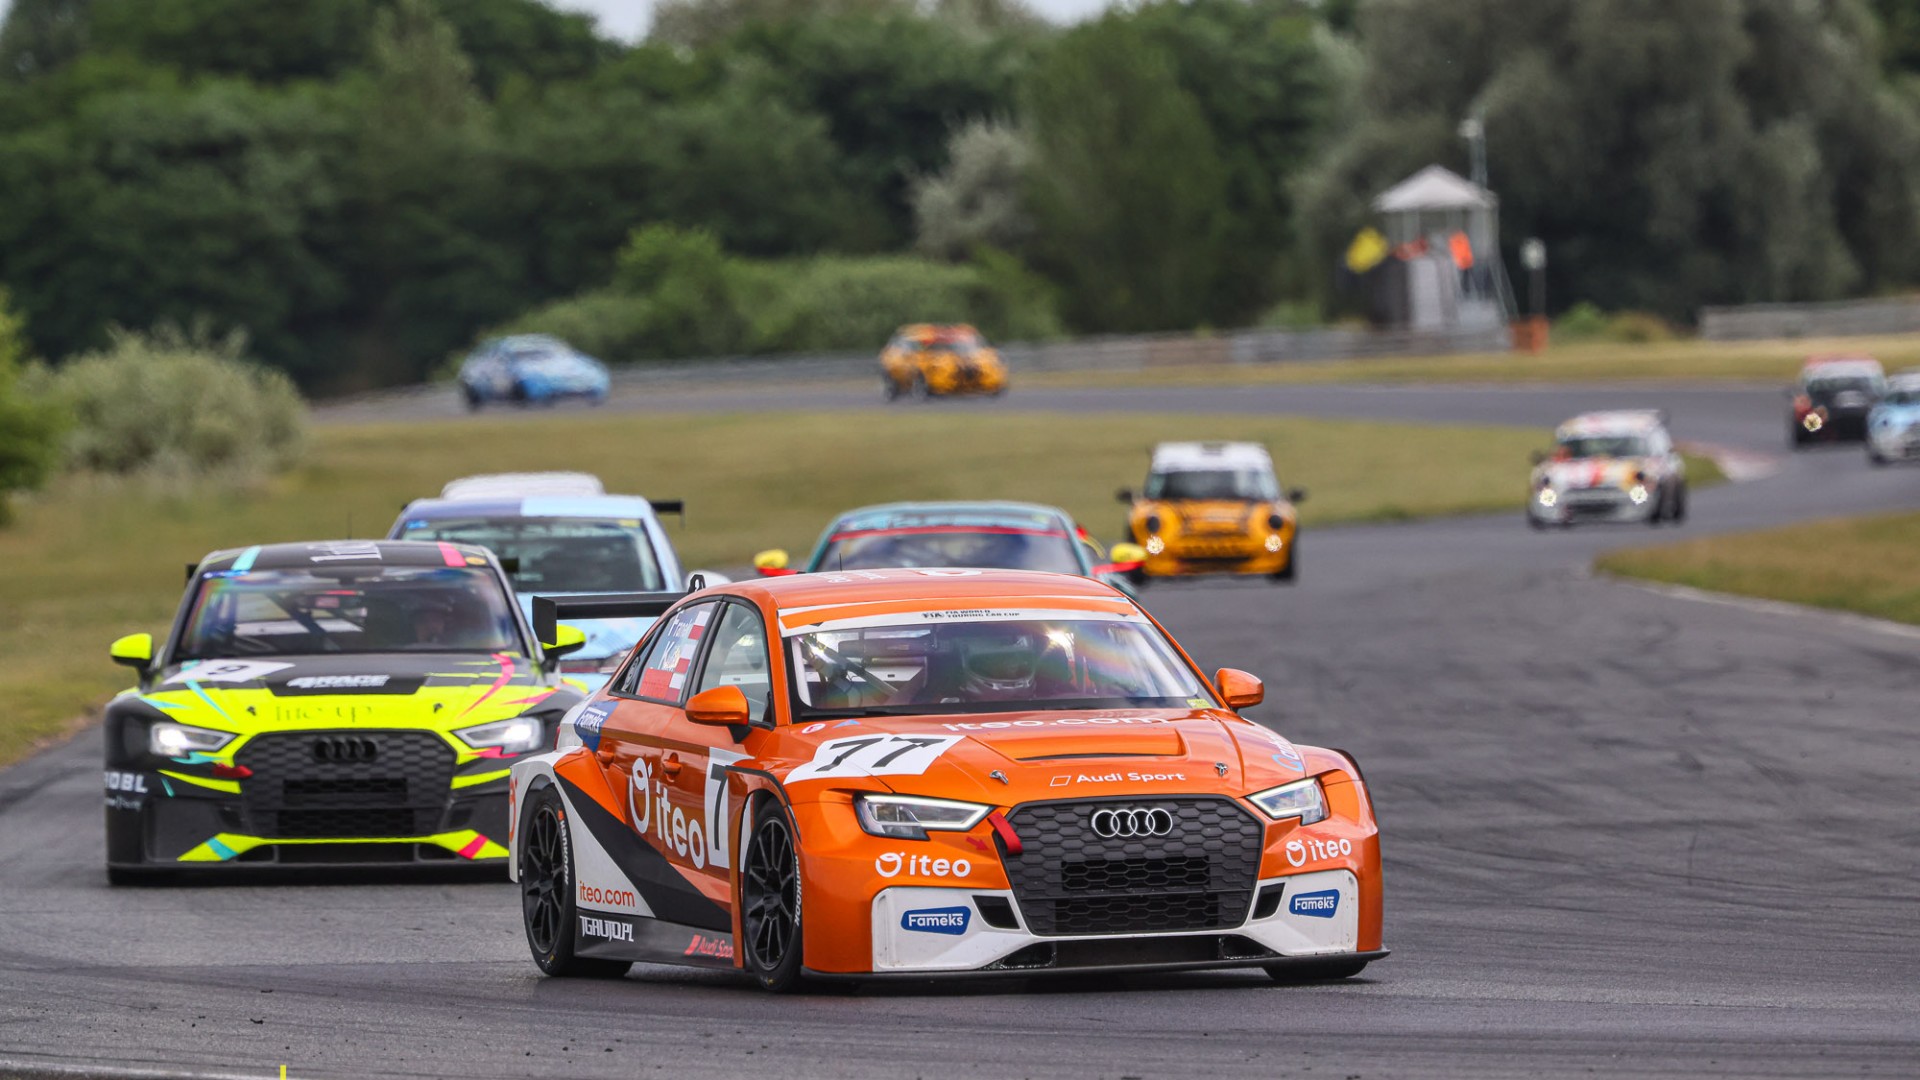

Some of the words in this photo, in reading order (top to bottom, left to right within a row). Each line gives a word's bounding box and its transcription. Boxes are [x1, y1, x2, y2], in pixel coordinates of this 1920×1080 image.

[942, 716, 1171, 732] iteo.com
[815, 736, 947, 773] 77
[1076, 773, 1122, 784] Audi
[1127, 771, 1187, 783] Sport
[656, 781, 705, 869] iteo
[1307, 838, 1352, 861] iteo
[909, 854, 971, 877] iteo
[579, 880, 636, 907] iteo.com
[1294, 896, 1335, 911] Fameks
[579, 915, 635, 943] TGAUTO.PL
[908, 913, 964, 927] Fameks
[698, 936, 719, 954] Audi
